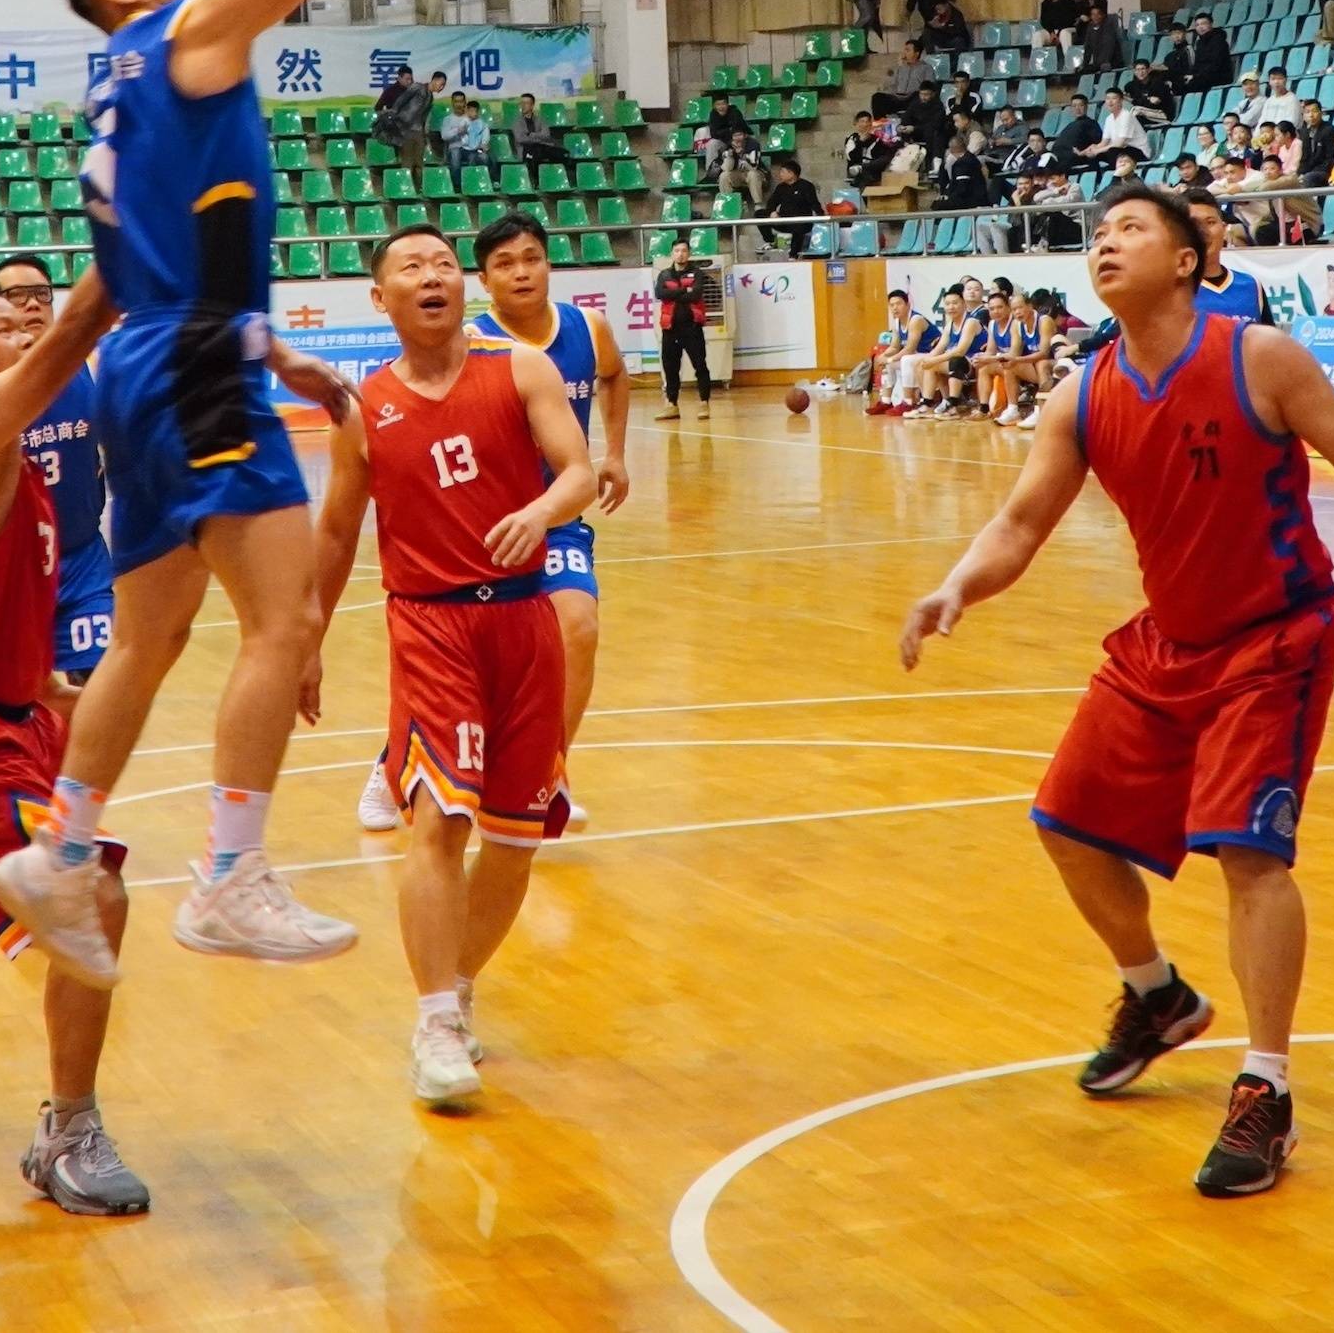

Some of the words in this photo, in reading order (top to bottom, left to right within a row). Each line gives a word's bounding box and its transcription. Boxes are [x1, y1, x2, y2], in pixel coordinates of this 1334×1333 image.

[429, 434, 479, 489] 13
[1188, 446, 1222, 482] 71
[69, 614, 112, 652] 03
[455, 721, 485, 772] 13
